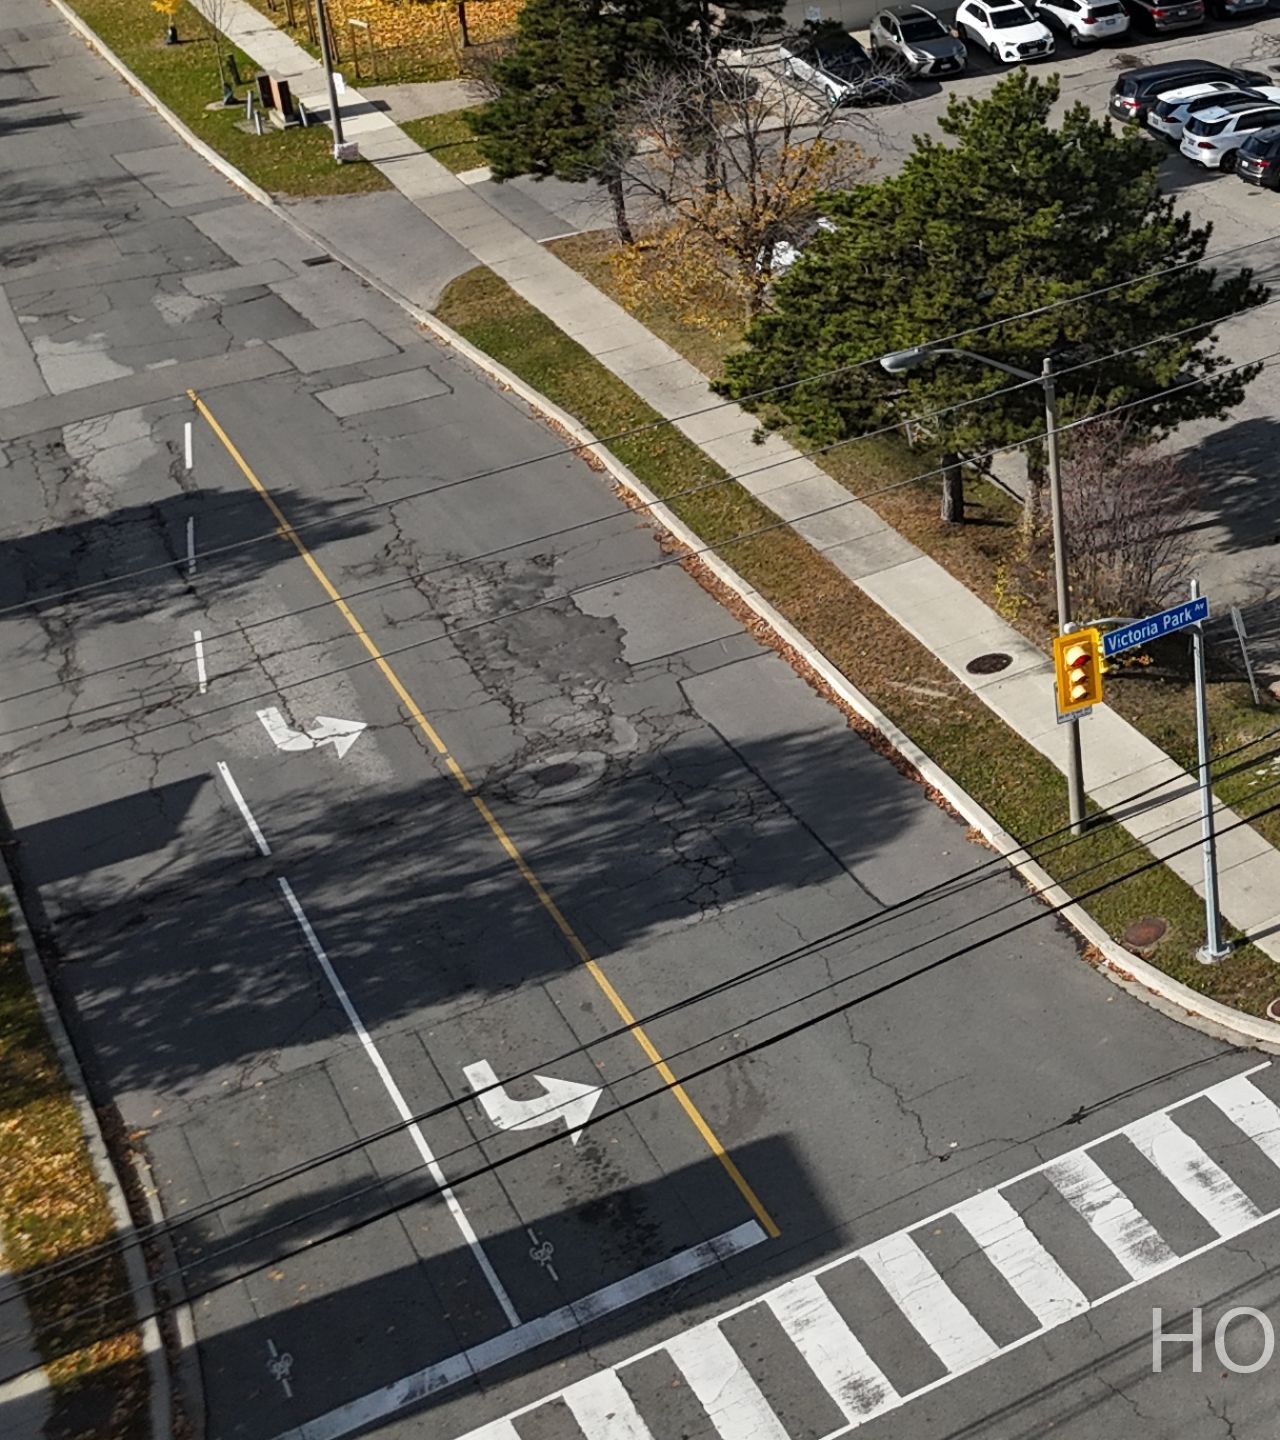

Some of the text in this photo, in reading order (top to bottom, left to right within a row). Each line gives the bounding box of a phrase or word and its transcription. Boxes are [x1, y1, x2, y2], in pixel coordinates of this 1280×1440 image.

[1108, 601, 1205, 651] Victoria Park Av
